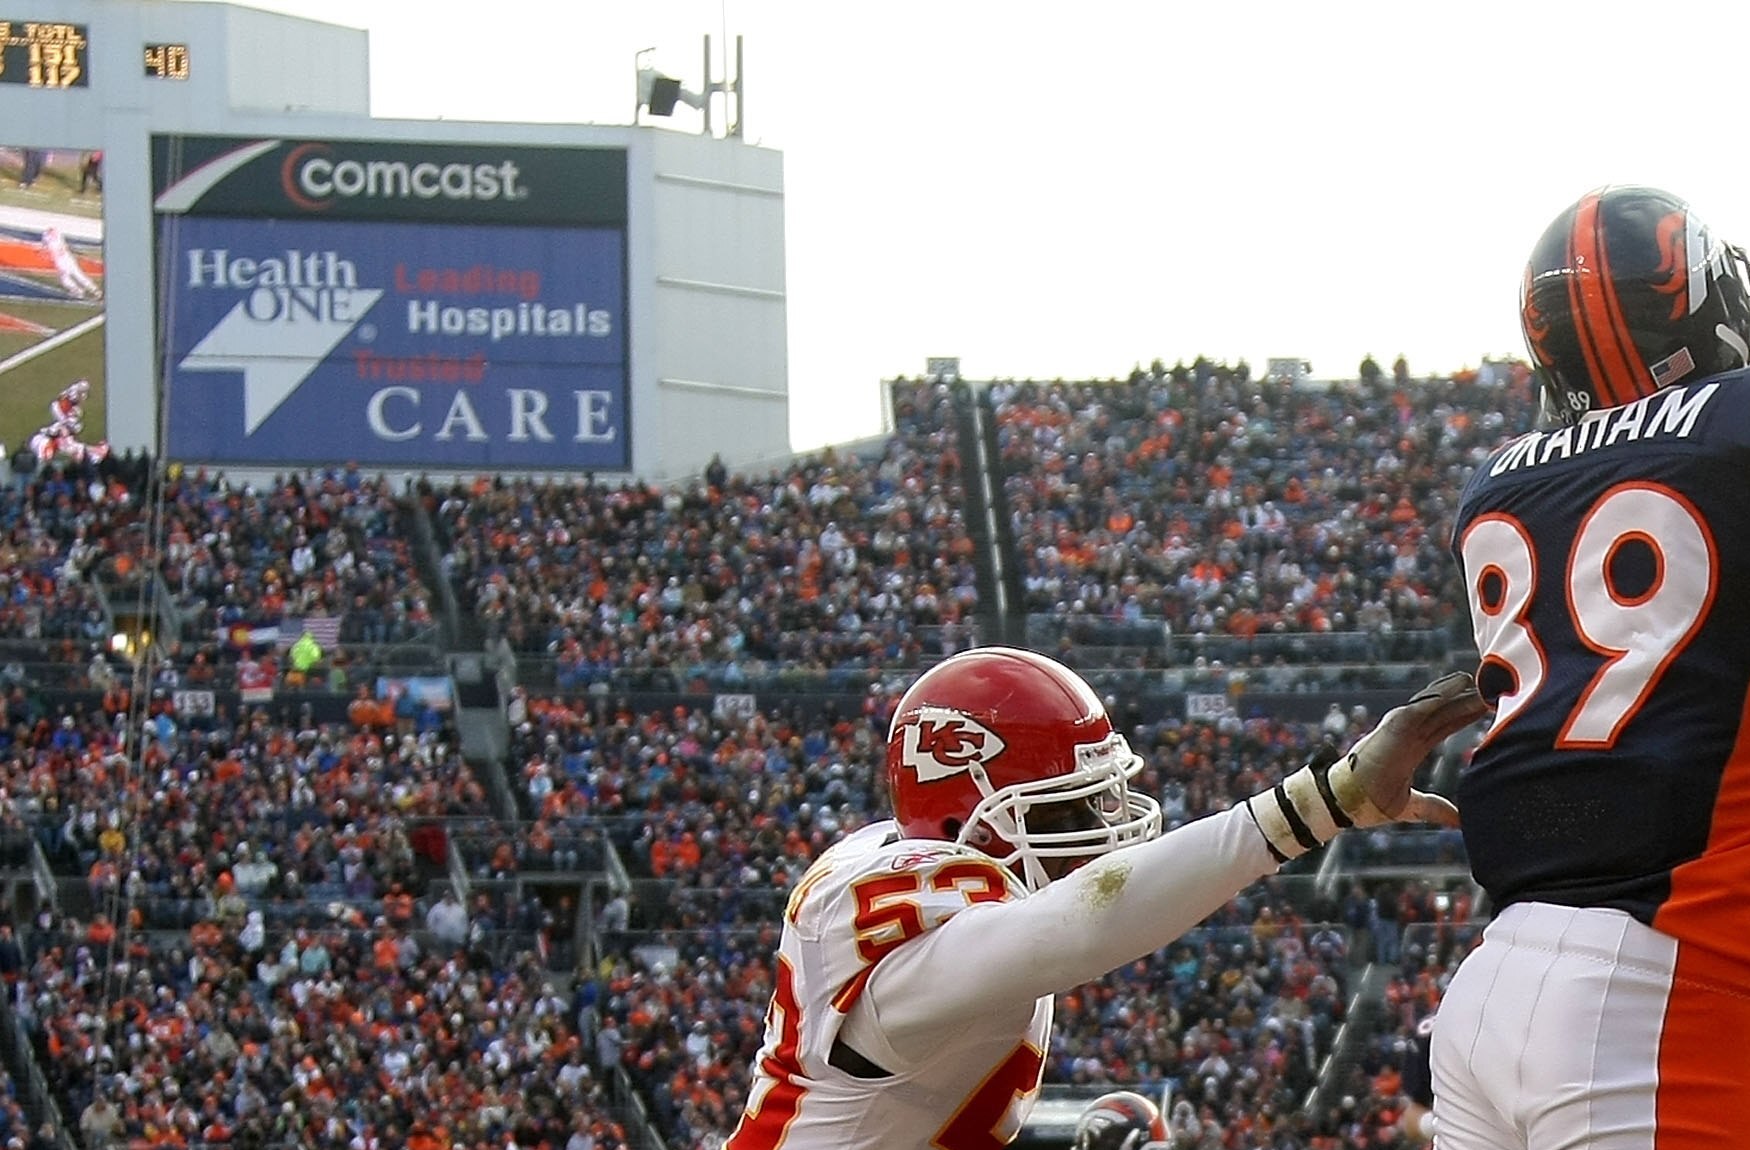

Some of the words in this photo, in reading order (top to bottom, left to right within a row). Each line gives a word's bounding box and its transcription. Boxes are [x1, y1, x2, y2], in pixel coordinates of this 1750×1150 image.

[145, 45, 189, 80] 40
[187, 249, 357, 288] Health
[394, 264, 541, 300] Leading
[247, 287, 354, 323] ONE
[408, 299, 612, 342] Hospitals
[353, 349, 487, 382] Trusted
[367, 386, 618, 443] CARE
[1566, 391, 1591, 411] 89
[1460, 480, 1720, 766] 89
[917, 720, 985, 767] KC
